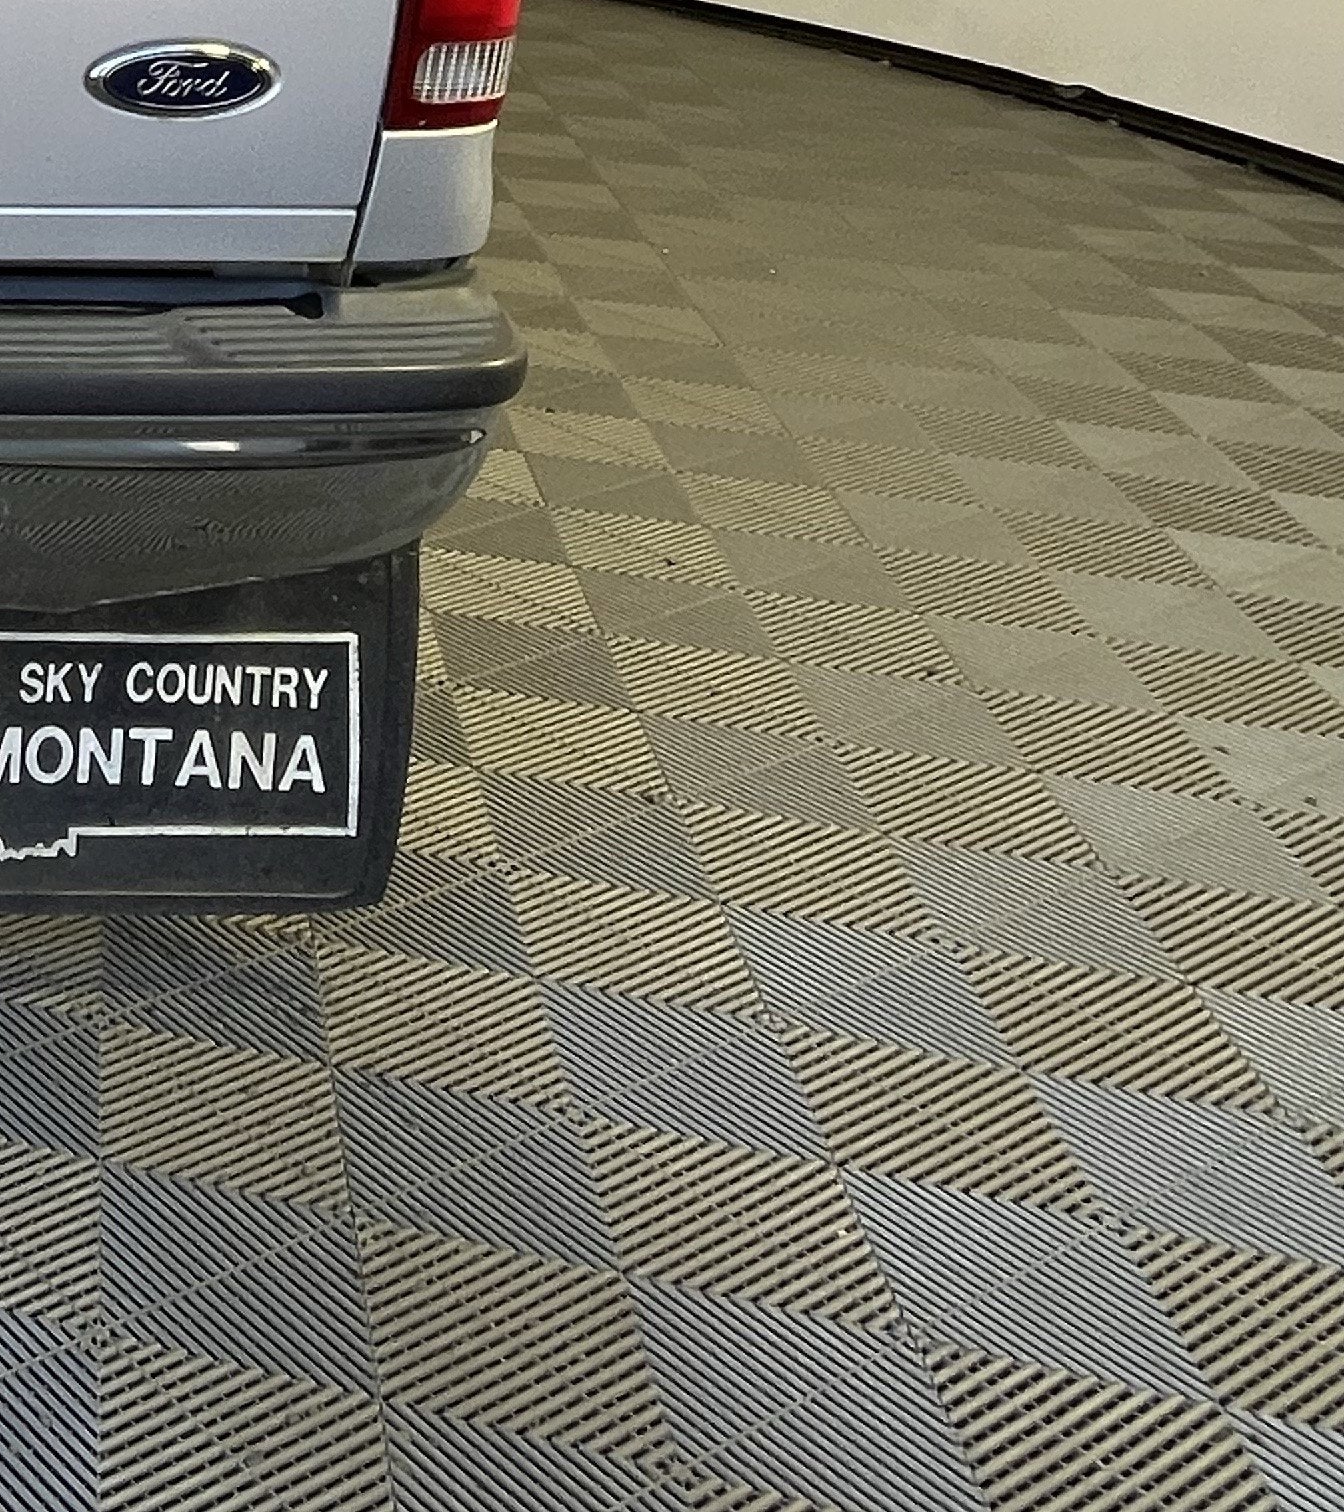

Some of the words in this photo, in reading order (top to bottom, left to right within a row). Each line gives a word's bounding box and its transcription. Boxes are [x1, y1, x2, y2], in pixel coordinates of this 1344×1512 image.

[136, 59, 231, 97] Ford
[18, 661, 103, 704] SKY
[125, 661, 329, 710] COUNTRY
